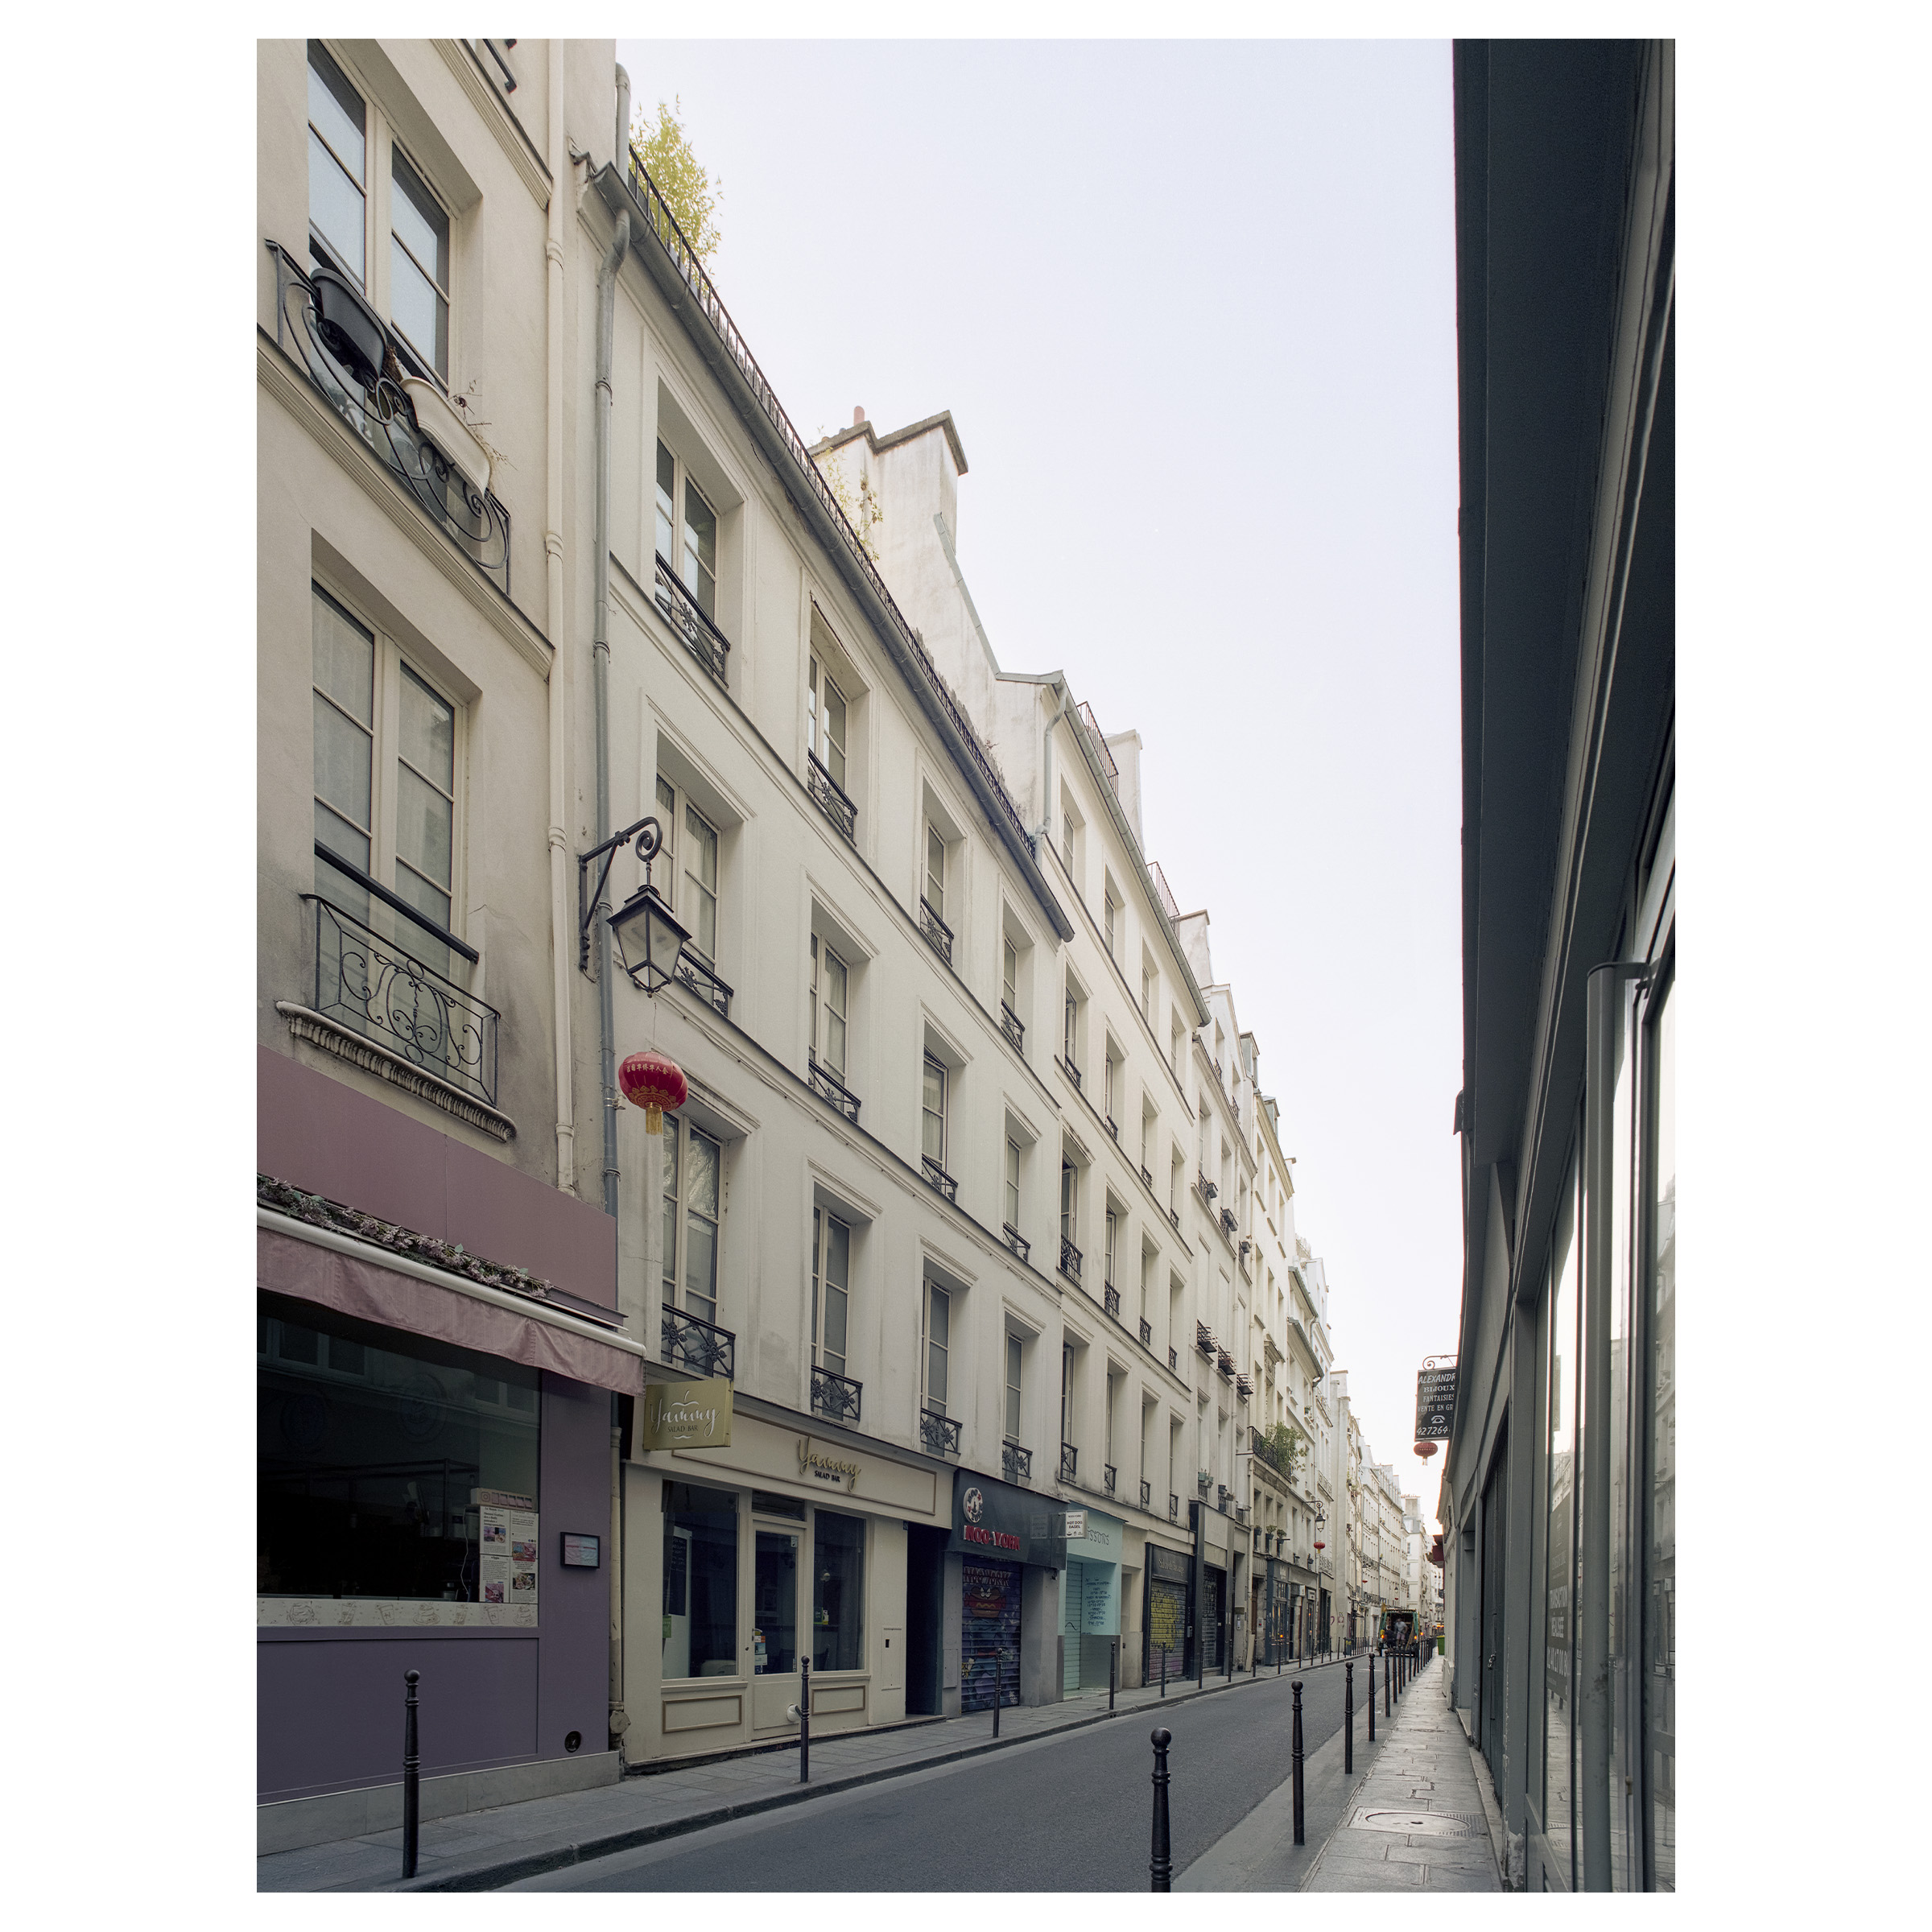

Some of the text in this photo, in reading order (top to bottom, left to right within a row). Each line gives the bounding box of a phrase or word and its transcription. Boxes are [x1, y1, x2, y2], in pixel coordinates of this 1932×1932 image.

[1423, 1385, 1455, 1393] BIJOUX
[815, 1470, 840, 1483] SALAD BAR
